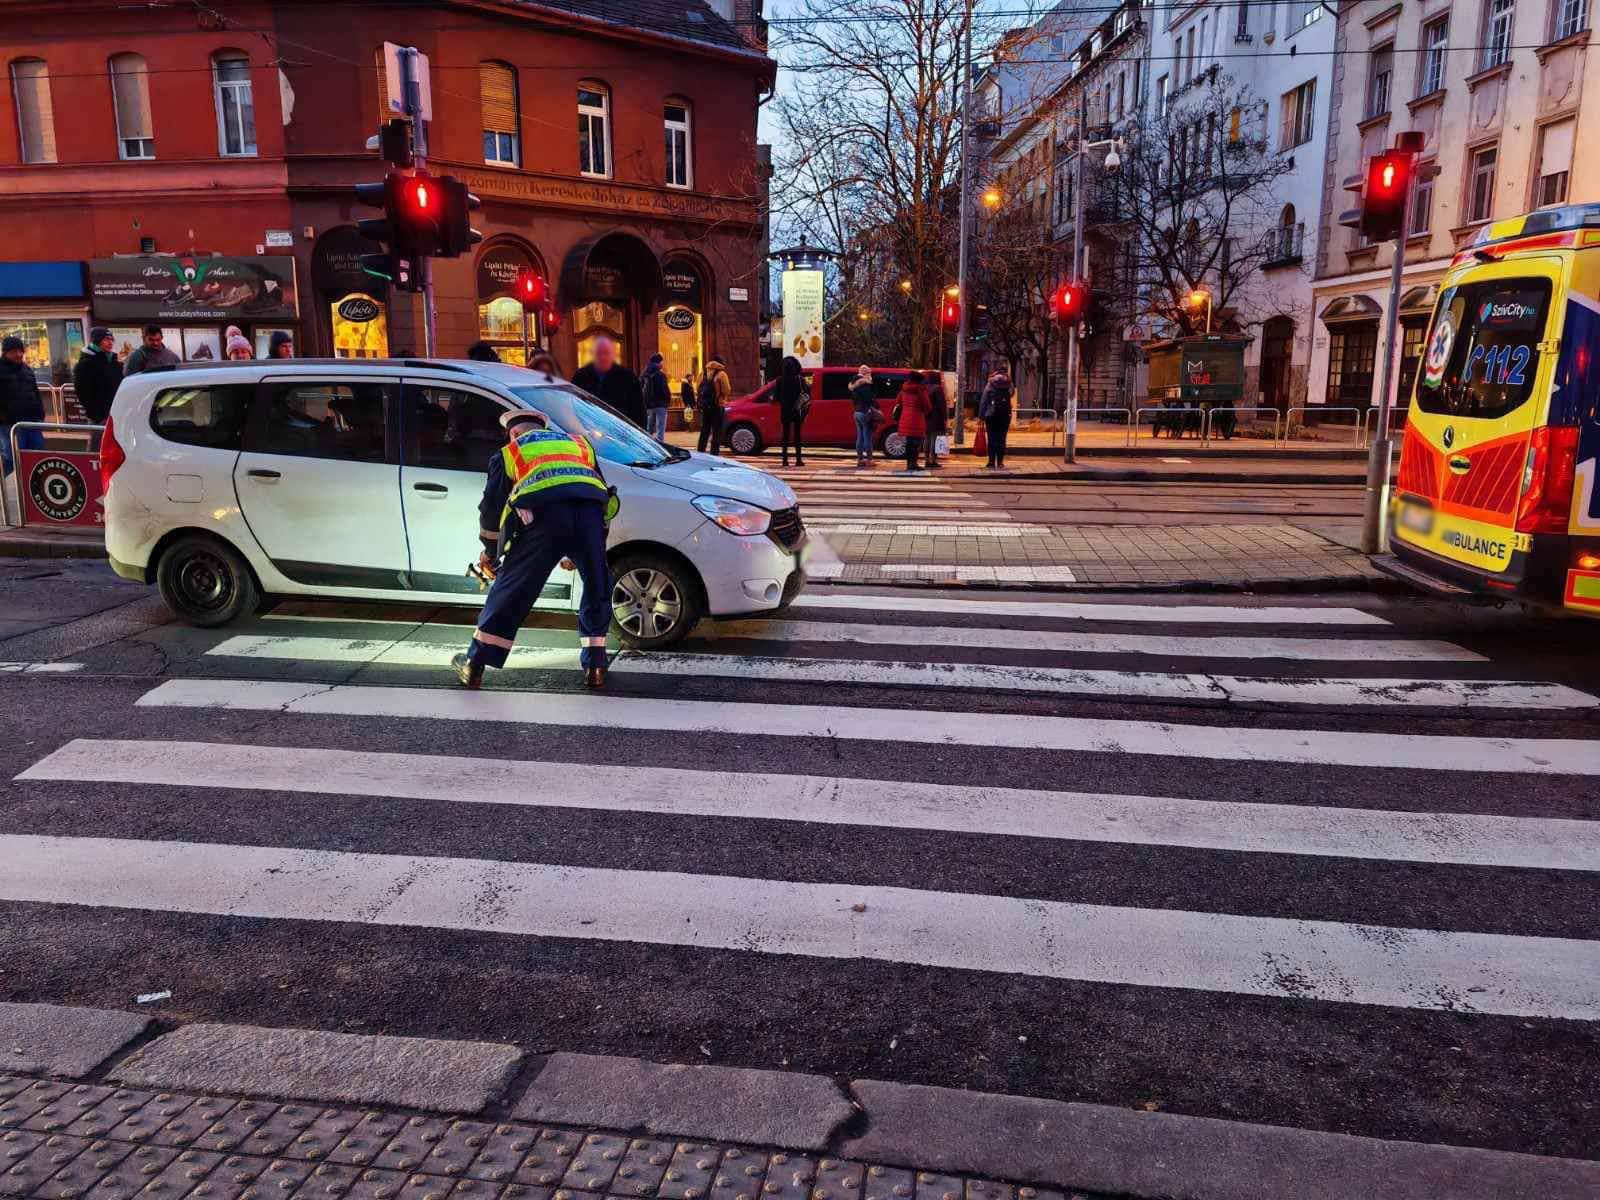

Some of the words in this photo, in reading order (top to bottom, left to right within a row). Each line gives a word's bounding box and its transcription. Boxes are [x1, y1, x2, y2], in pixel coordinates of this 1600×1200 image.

[341, 300, 374, 320] Lipóti
[1484, 344, 1530, 385] 112
[37, 461, 76, 476] NEMZETI
[53, 484, 64, 496] T
